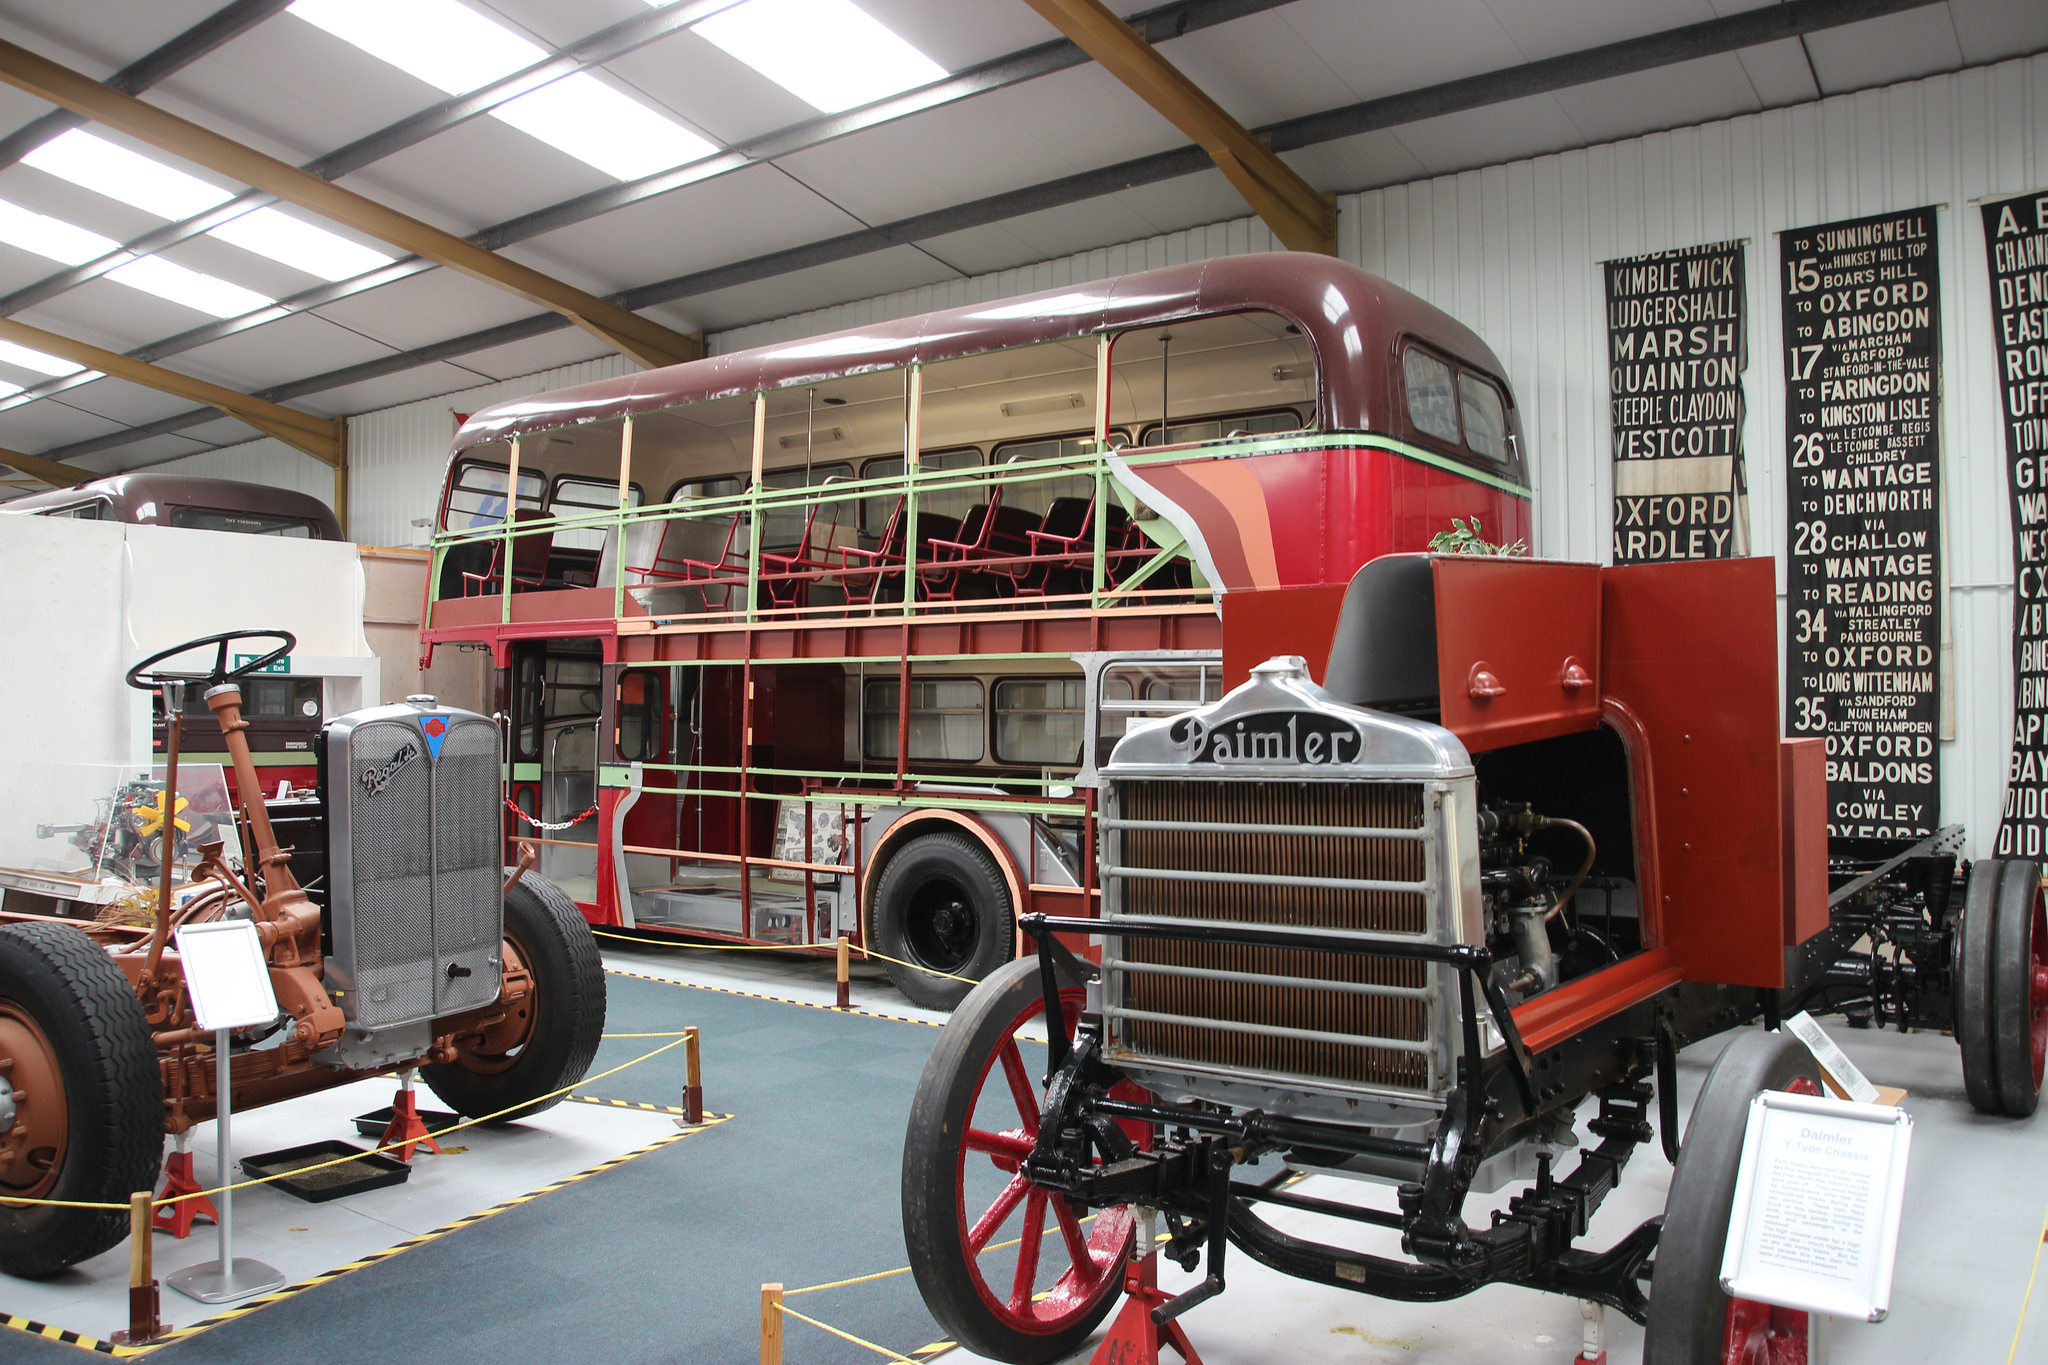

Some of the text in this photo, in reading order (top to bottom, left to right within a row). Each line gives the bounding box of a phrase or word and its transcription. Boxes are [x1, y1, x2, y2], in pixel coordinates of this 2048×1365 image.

[1794, 217, 1927, 253] TO SUNNINGWELL
[1819, 242, 1927, 271] VIA HINKSEY HILL TOP
[1613, 255, 1735, 297] KIMBLE WICK
[1788, 257, 1820, 295] 15
[1824, 263, 1918, 289] BOAR'S HILL
[1610, 289, 1737, 330] LUDGERSHALL
[1796, 281, 1928, 314] TO OXFORD
[1797, 306, 1929, 341] TO ABINGDON
[1614, 322, 1733, 362] MARSH
[1832, 332, 1911, 352] VIA MARCHAM
[1791, 343, 1824, 381] 17
[1823, 356, 1930, 379] STANFORD-IN-THE-VALE
[1842, 346, 1904, 364] GARFORD
[1611, 356, 1737, 394] QUAINTON
[1799, 371, 1930, 402] TO FARINGDON
[1612, 390, 1736, 428] STEEPLE CLAYDON
[1800, 397, 1930, 428] TO KINGSTON LISLE
[1825, 421, 1931, 441] VIA LETCOMBE REGIS
[1792, 432, 1824, 468] 26
[1830, 435, 1925, 454] LETCOMBE BASSETT
[1846, 449, 1907, 466] CHILDREY
[1801, 462, 1931, 490] TO WANTAGE
[1802, 488, 1932, 516] TO DENCHWORTH
[1864, 519, 1885, 531] VIA
[1794, 520, 1827, 556] 28
[1831, 531, 1927, 551] CHALLOW
[1802, 553, 1932, 579] TO WANTAGE
[1803, 580, 1933, 605] TO READING
[1834, 604, 1932, 618] VIA WALLINGFORD
[1795, 608, 1828, 644] 34
[1848, 618, 1921, 631] STREATLEY
[1840, 631, 1922, 644] PANGBOURNE
[273, 664, 285, 672] Exit
[1802, 645, 1933, 667] TO OXFORD
[1802, 671, 1933, 693] TO LONG WITTENHAM
[1794, 696, 1827, 731] 35
[1839, 695, 1916, 707] VIA SANDFORD
[1847, 708, 1907, 720] NUNEHAM
[1170, 713, 1355, 765] Daimler
[1827, 721, 1932, 734] CLIFTON HAMPDEN
[1825, 735, 1933, 757] OXFORD
[1825, 761, 1933, 784] BALDONS
[1863, 788, 1886, 800] VIA
[1836, 802, 1923, 821] COWLEY
[1999, 823, 2048, 856] DID
[1784, 1140, 1822, 1155] Y-Type
[1801, 1127, 1854, 1147] Daimler
